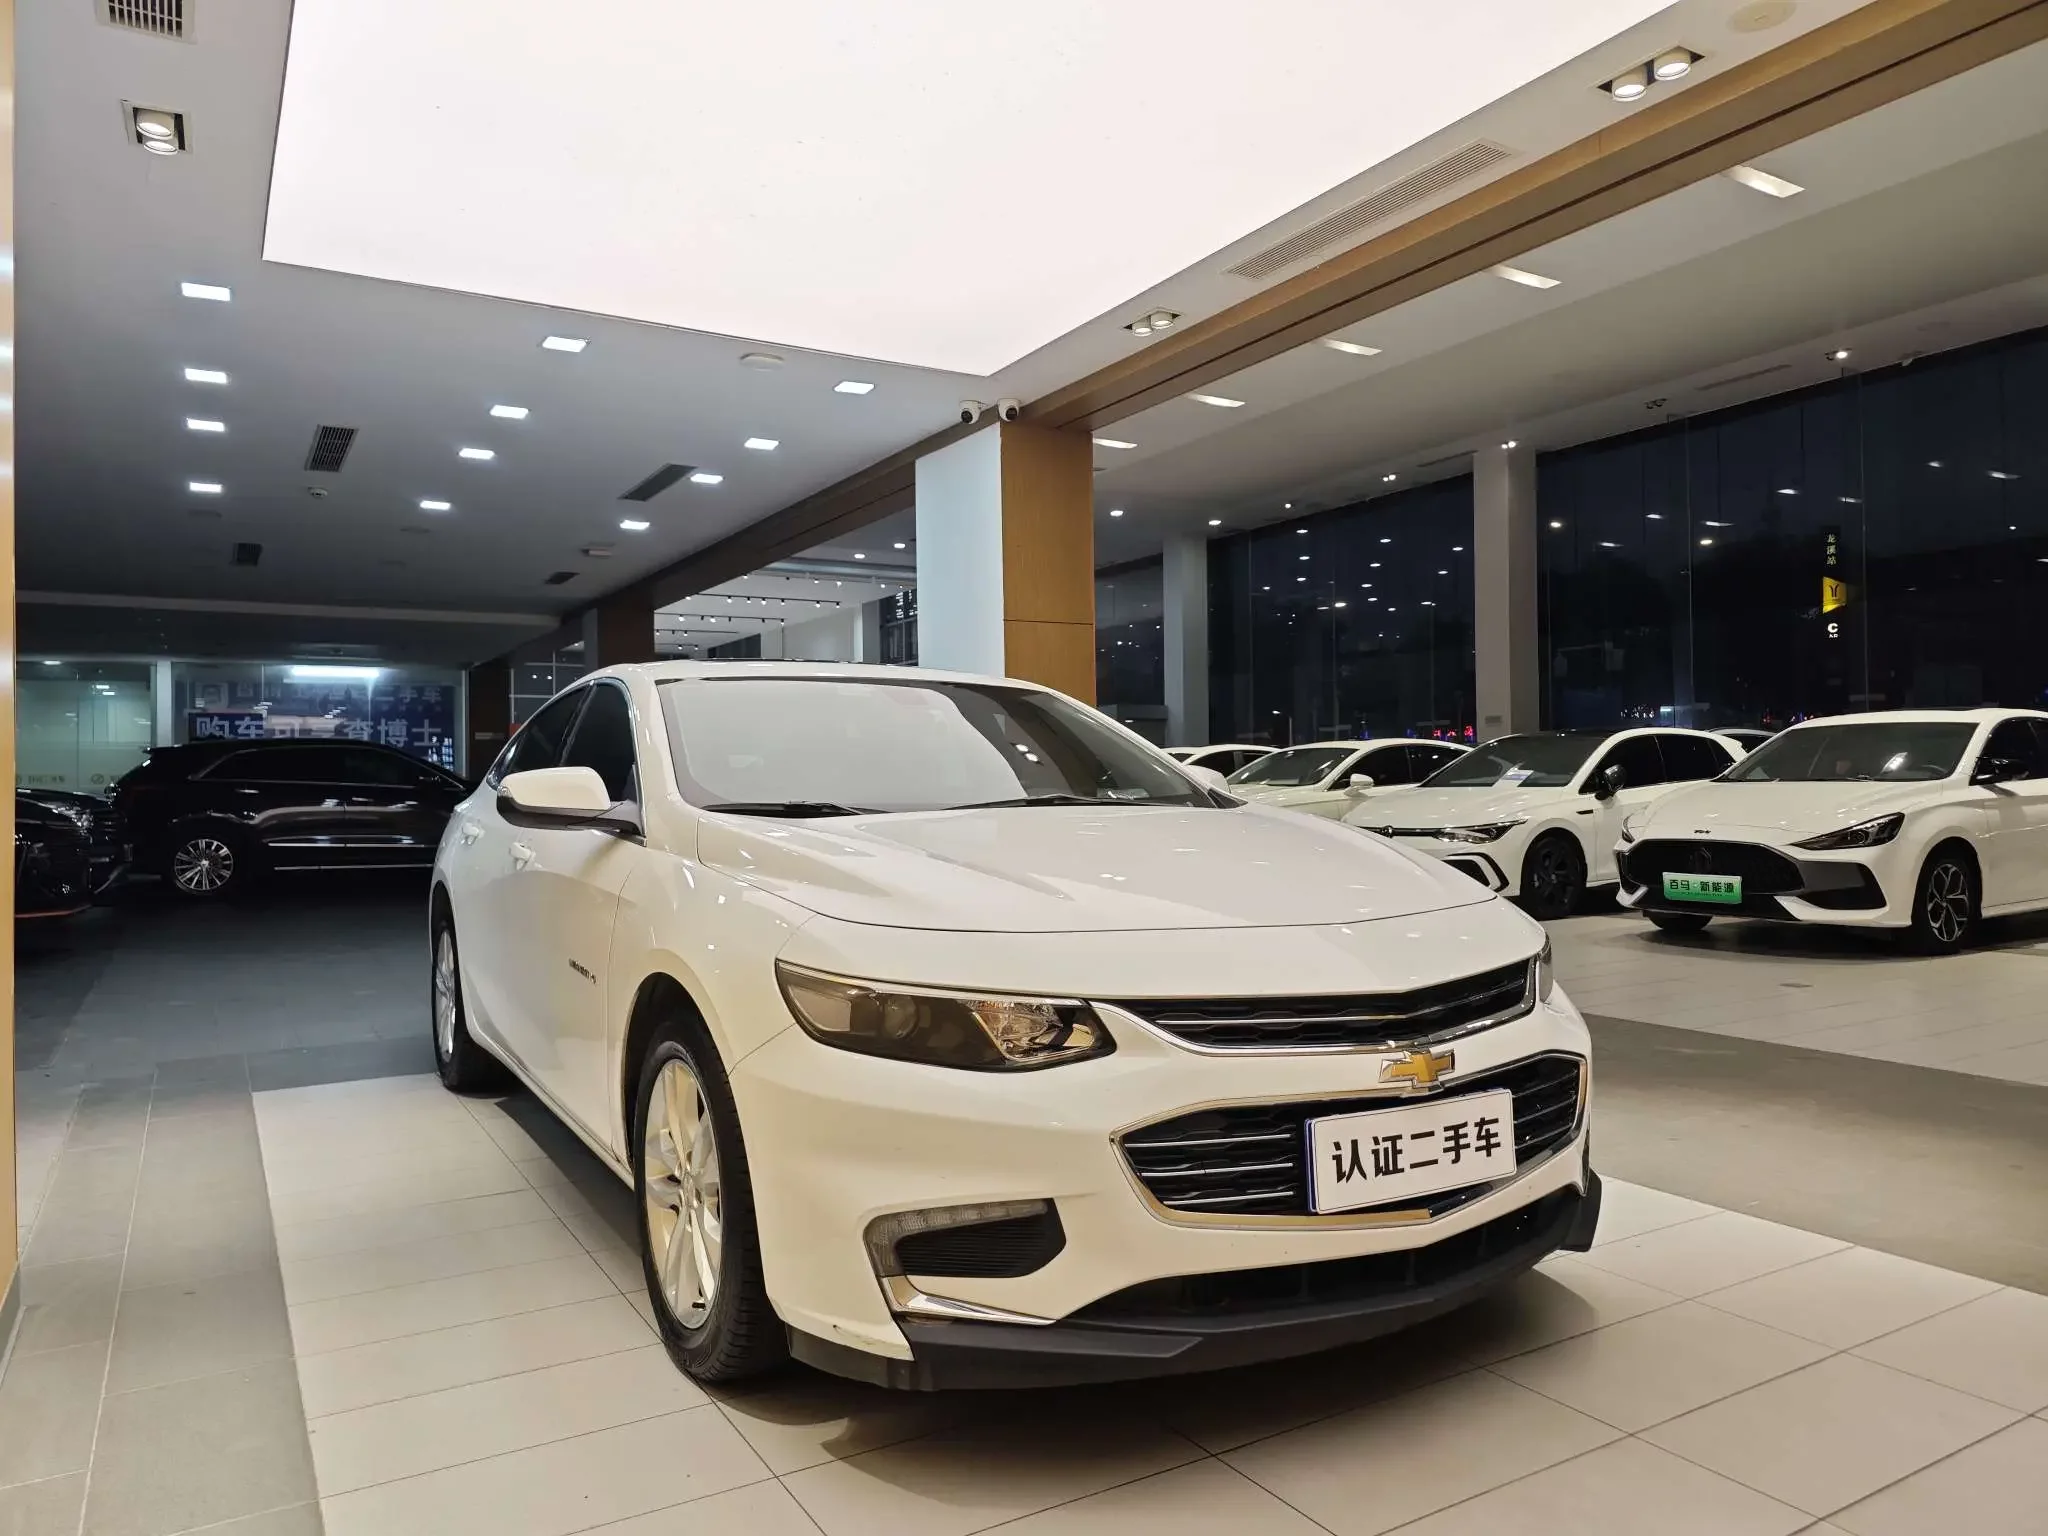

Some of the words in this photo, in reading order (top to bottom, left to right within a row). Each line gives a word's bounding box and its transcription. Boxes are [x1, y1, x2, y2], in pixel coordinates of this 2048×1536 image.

[1828, 623, 1838, 632] C
[1332, 1117, 1501, 1183] 认证二手车
